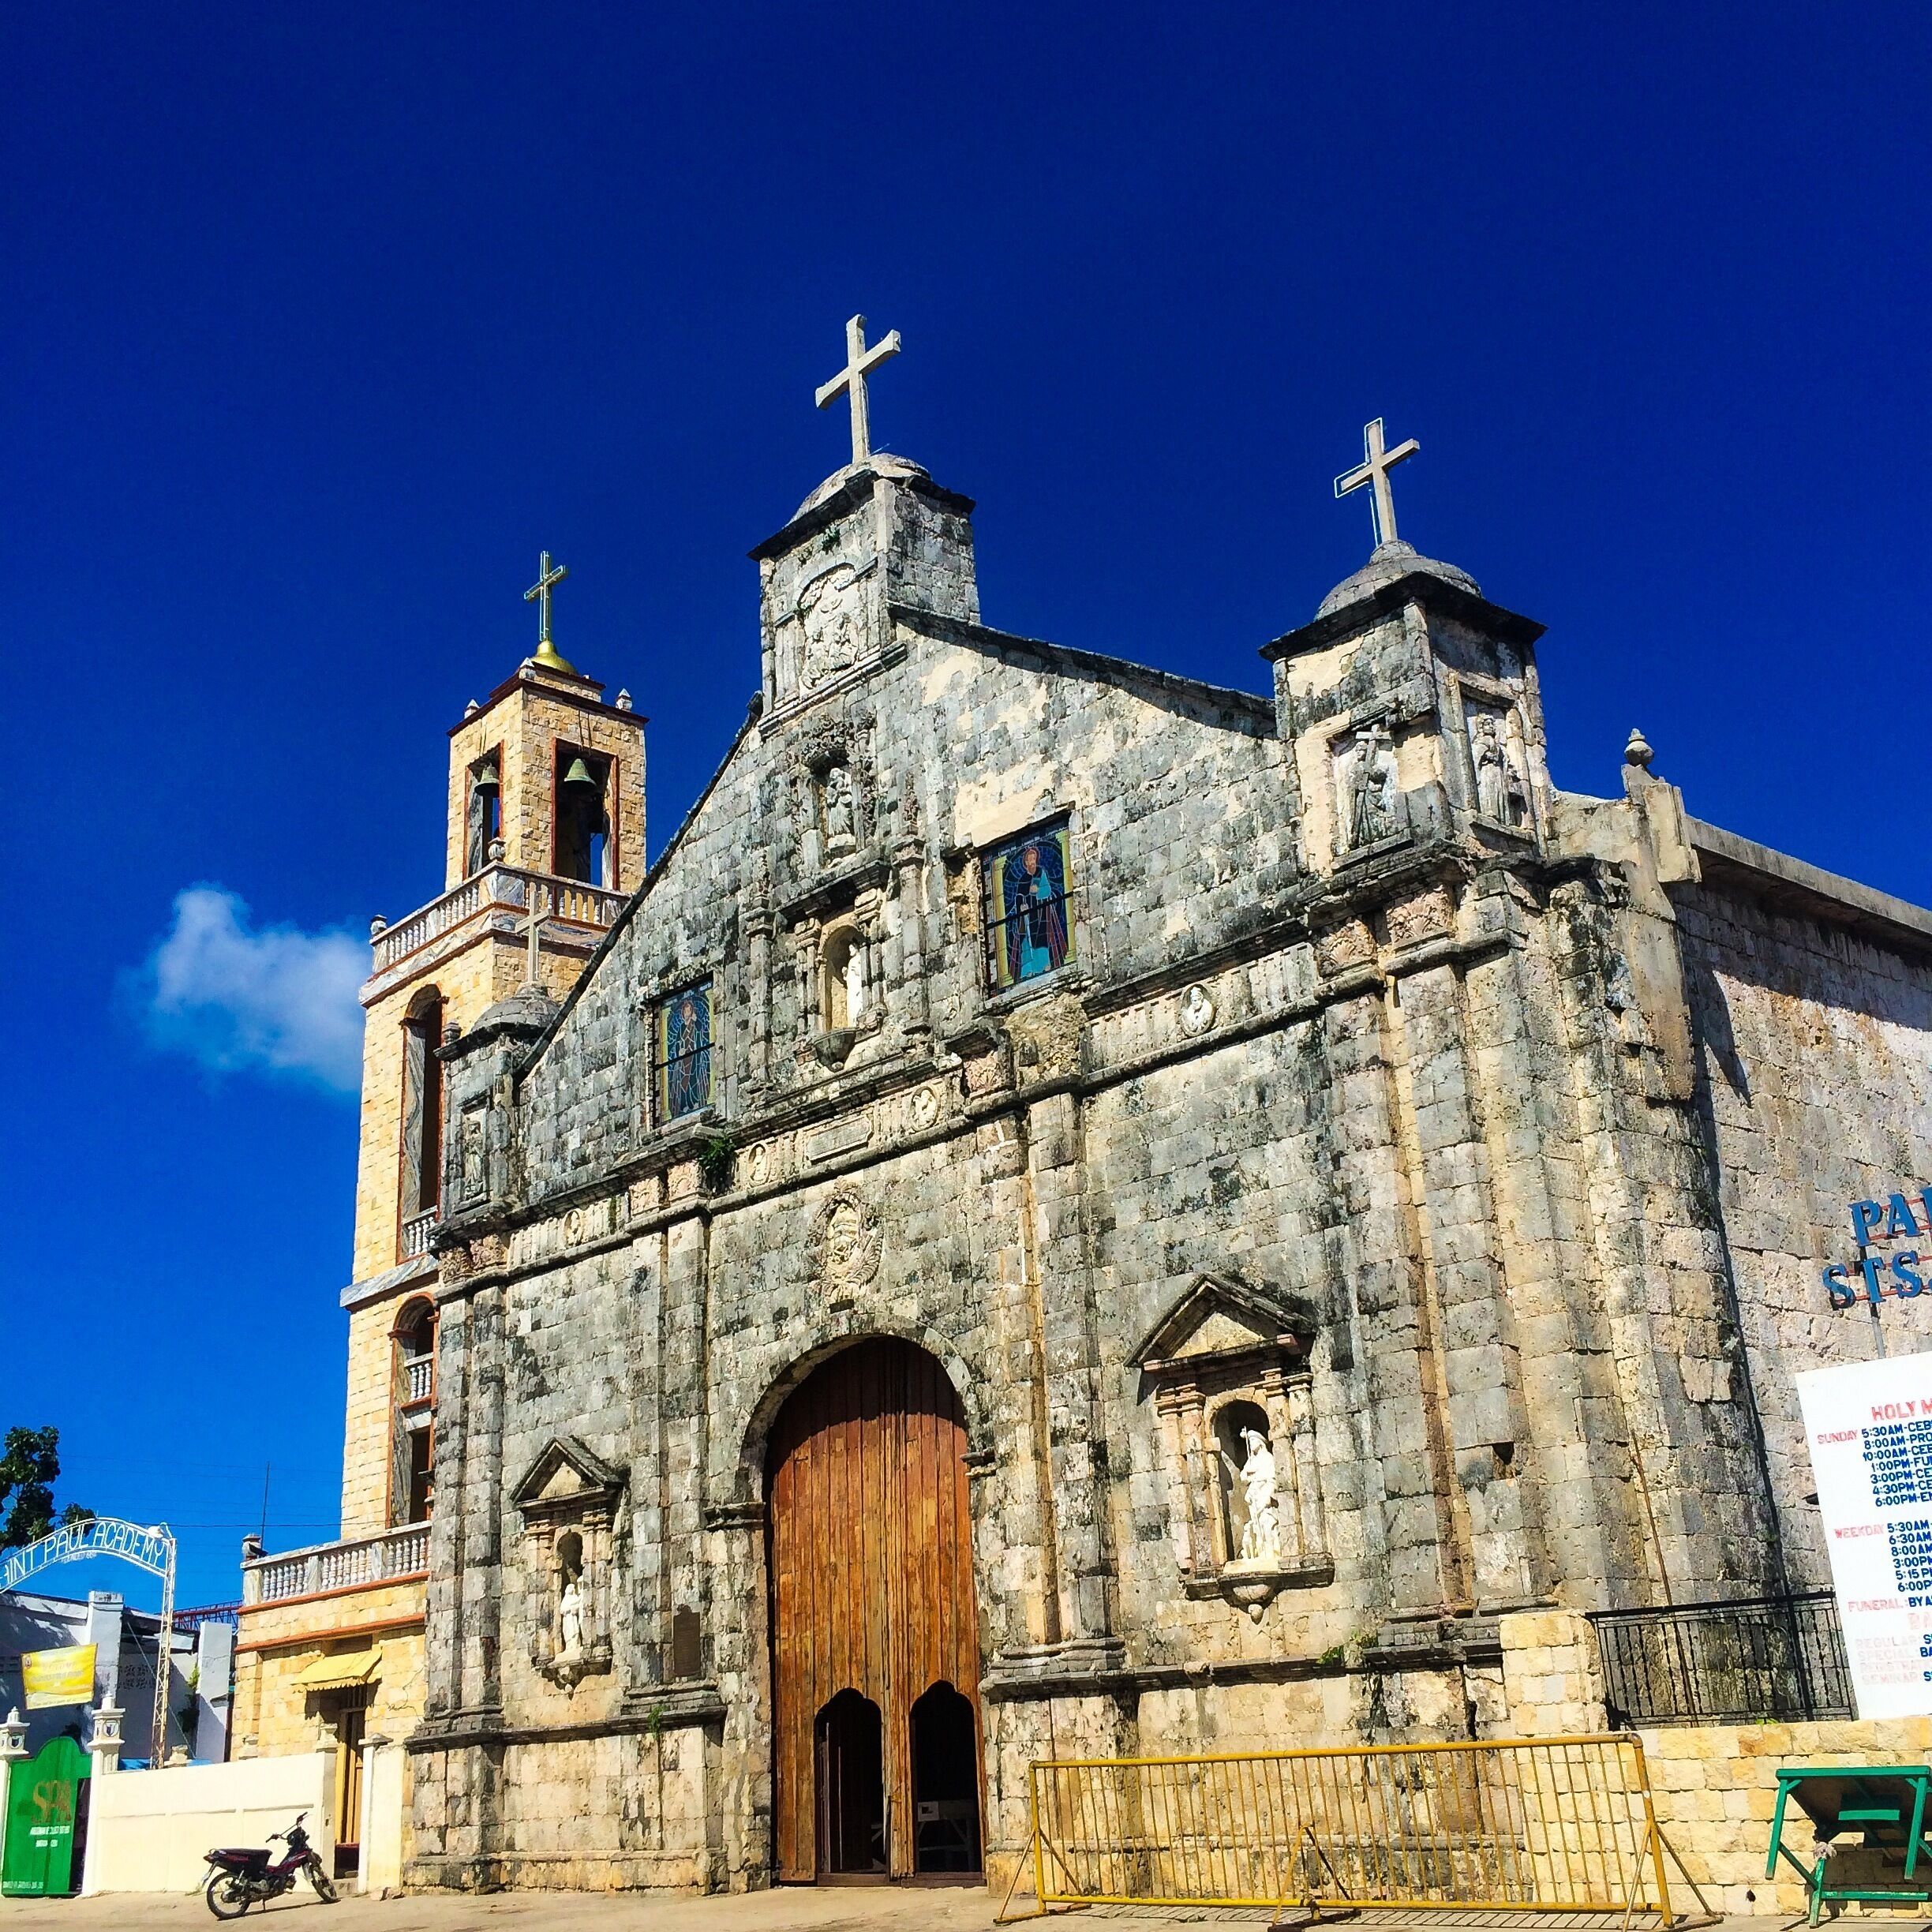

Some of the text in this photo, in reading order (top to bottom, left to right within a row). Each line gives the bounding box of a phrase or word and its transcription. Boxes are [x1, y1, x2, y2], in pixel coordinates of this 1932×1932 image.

[1871, 1401, 1915, 1421] HOLY
[1817, 1420, 1932, 1444] SUNDAY 5:30AM-CEB
[1835, 1524, 1885, 1539] WEEKDAY
[0, 1522, 165, 1588] AINT PAUL ACADEMY
[1898, 1579, 1932, 1592] 6:00P
